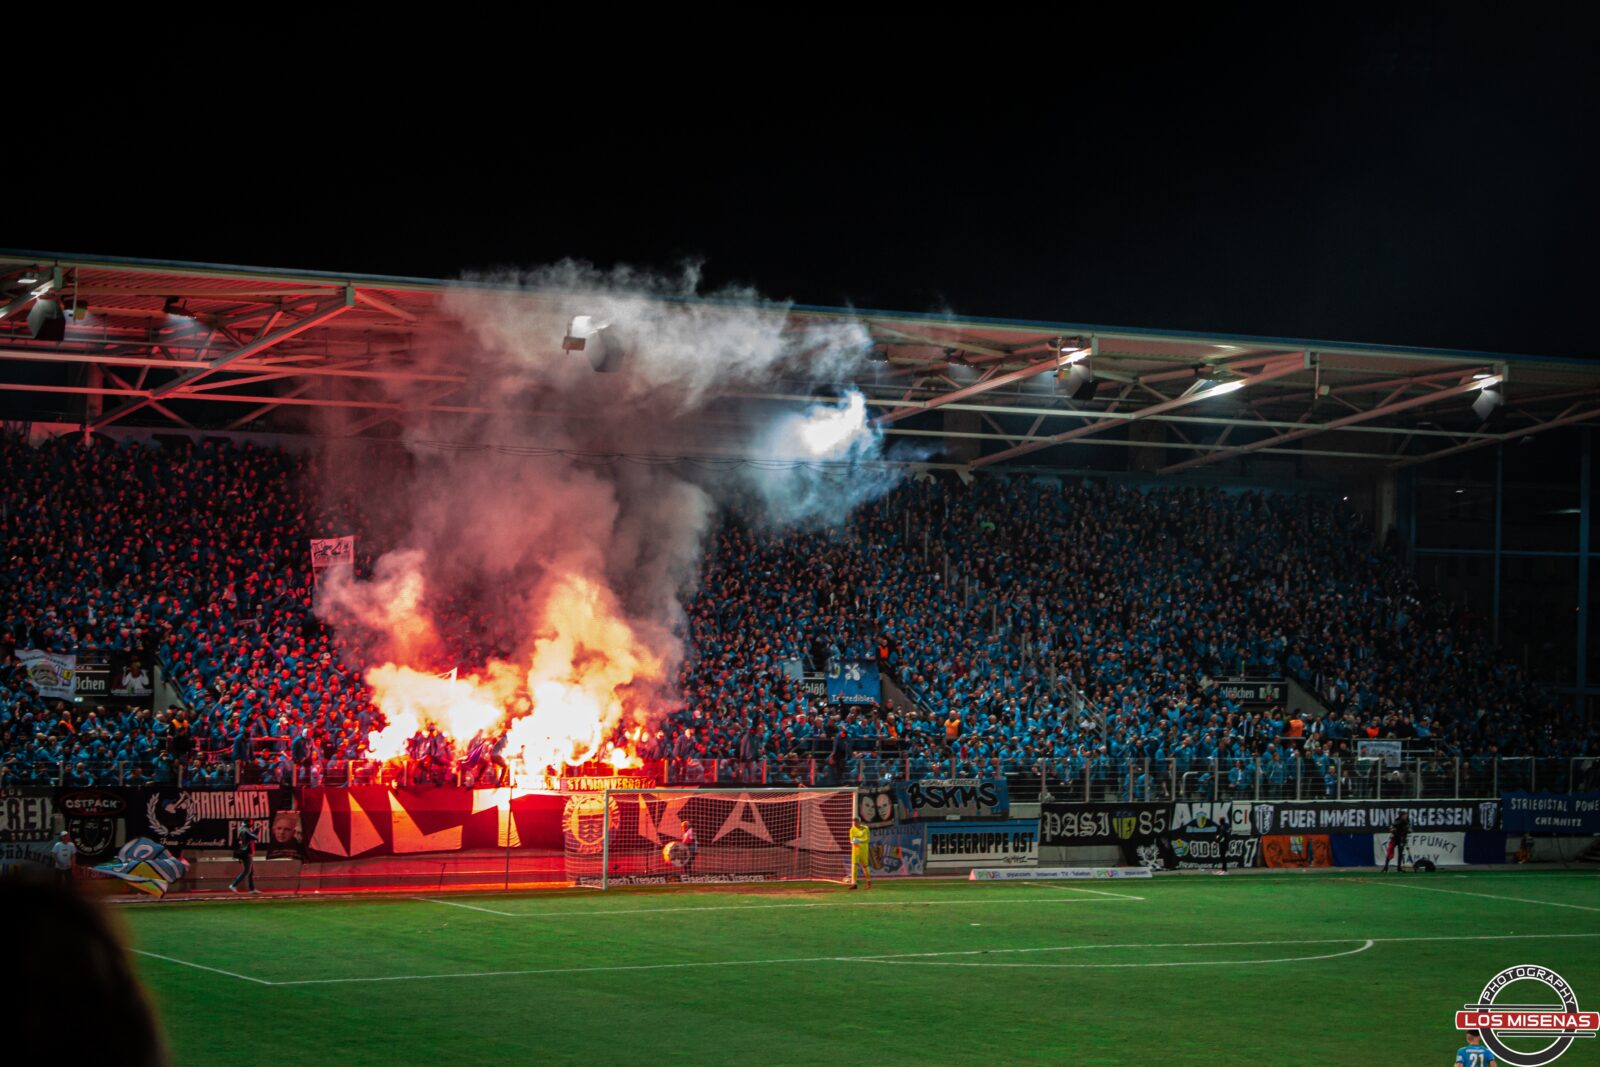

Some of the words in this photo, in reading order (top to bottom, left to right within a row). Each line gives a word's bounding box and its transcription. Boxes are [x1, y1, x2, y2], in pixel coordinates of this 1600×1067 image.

[65, 799, 118, 809] OSTPACK
[1510, 797, 1568, 813] STRIEGISTAL
[1138, 808, 1166, 835] 85
[1279, 809, 1317, 829] FUER
[1319, 808, 1367, 828] IMMER
[1534, 816, 1583, 828] CHEMNITZ
[931, 832, 1009, 855] REISEGRUPPE
[1012, 831, 1035, 853] OST
[1469, 1053, 1485, 1067] 21
